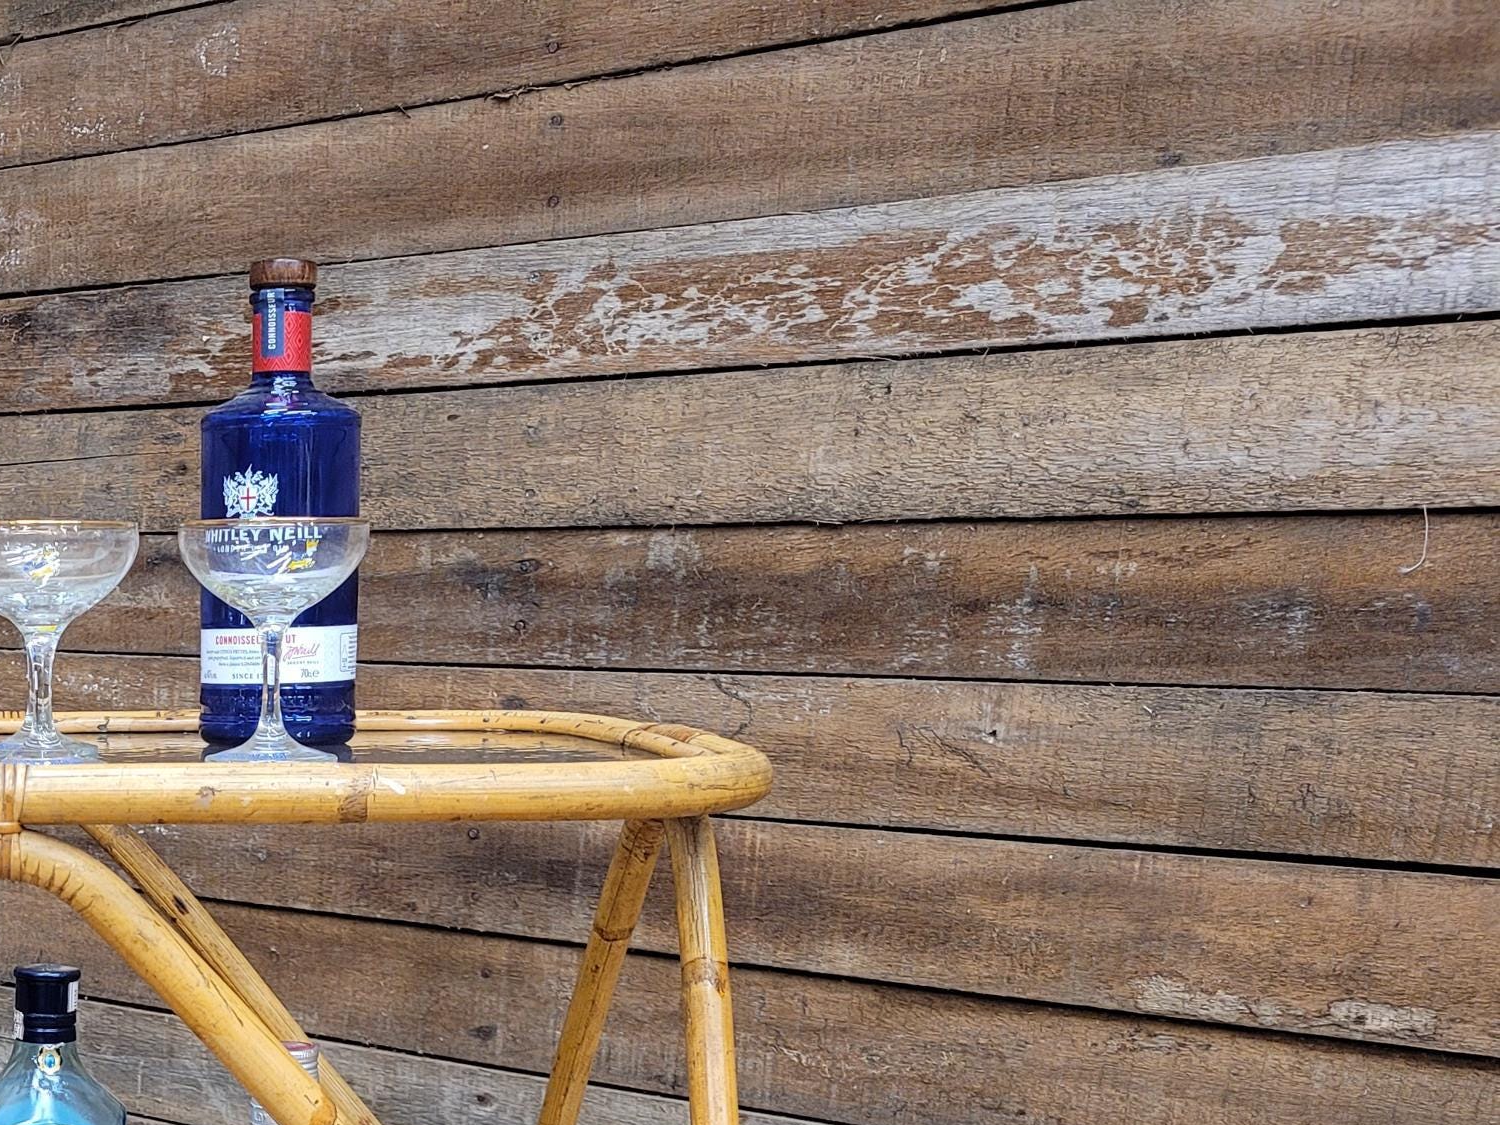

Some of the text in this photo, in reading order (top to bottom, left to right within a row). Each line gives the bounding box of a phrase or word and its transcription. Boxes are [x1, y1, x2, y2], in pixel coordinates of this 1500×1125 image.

[267, 289, 277, 350] CONNOISSEUR
[205, 526, 323, 543] WHITLEY NEILL
[215, 634, 296, 645] CONNOISSE UT
